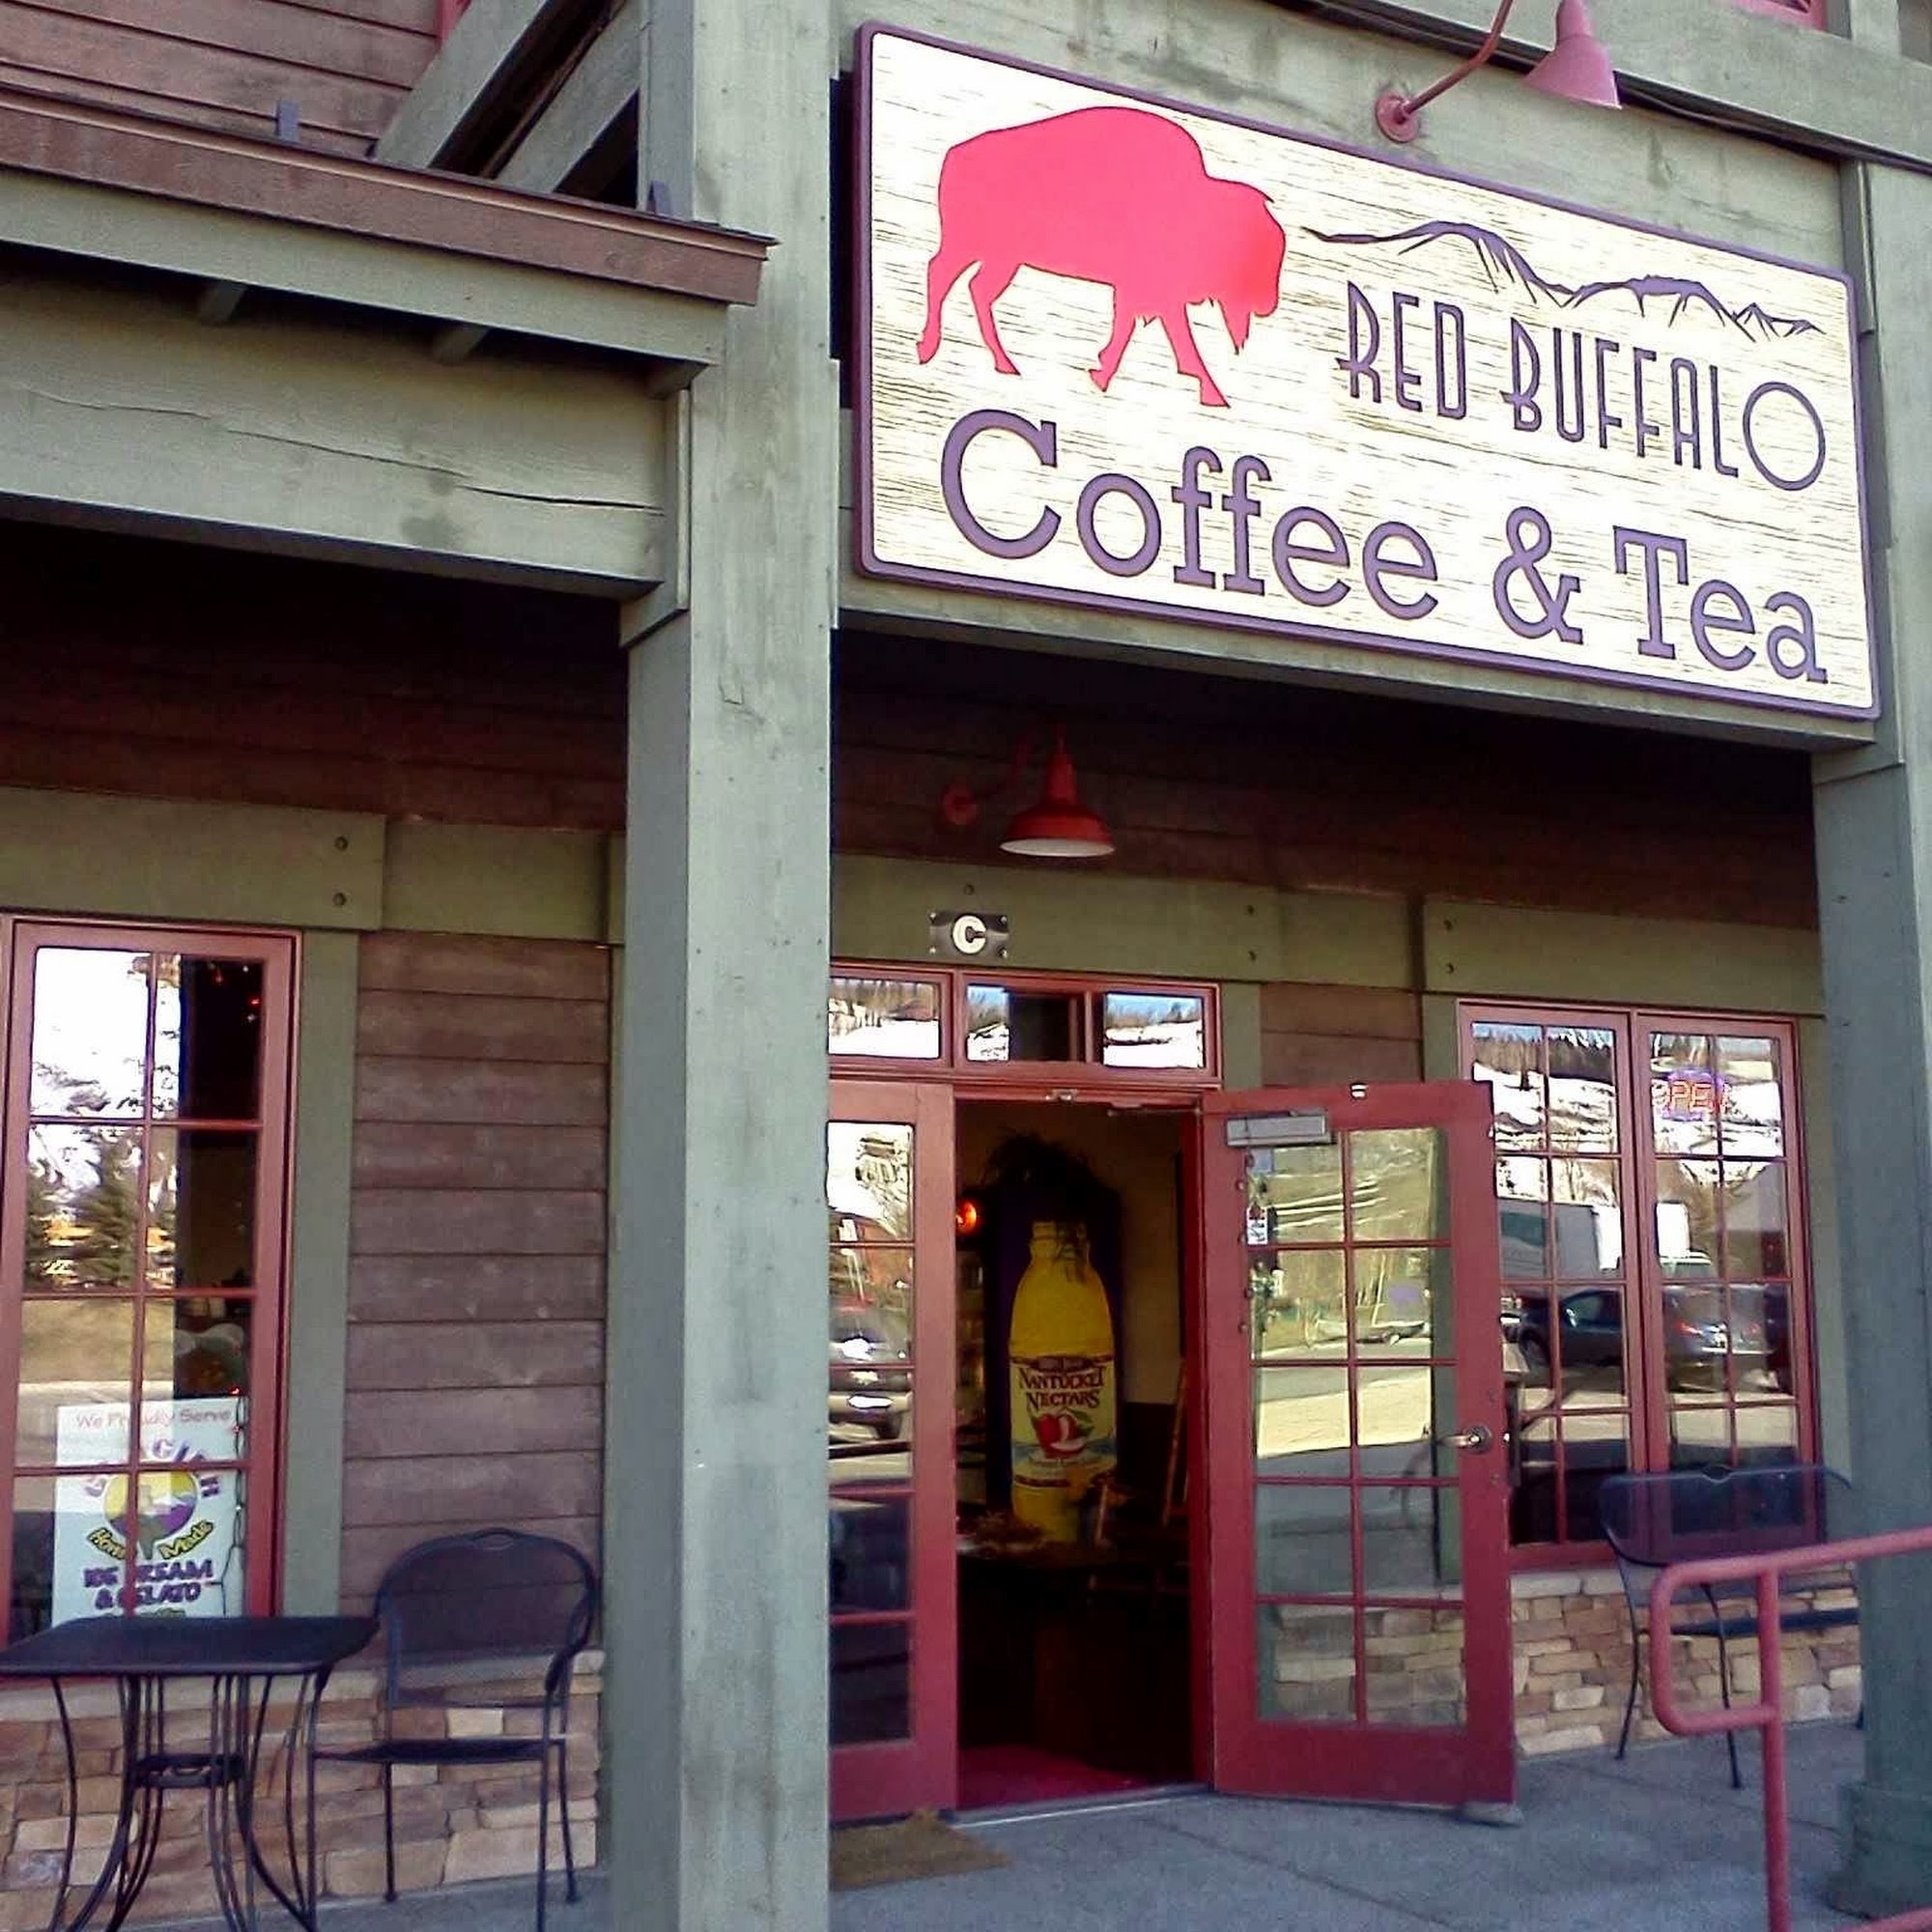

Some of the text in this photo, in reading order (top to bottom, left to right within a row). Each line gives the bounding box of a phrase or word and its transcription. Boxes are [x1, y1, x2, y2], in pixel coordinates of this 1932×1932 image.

[1335, 280, 1827, 492] RED BUFFALO
[941, 409, 1828, 684] Coffee & Tea
[952, 915, 987, 955] C
[76, 1413, 102, 1428] We
[181, 1408, 231, 1423] Serve
[1026, 1390, 1100, 1410] NECTARS
